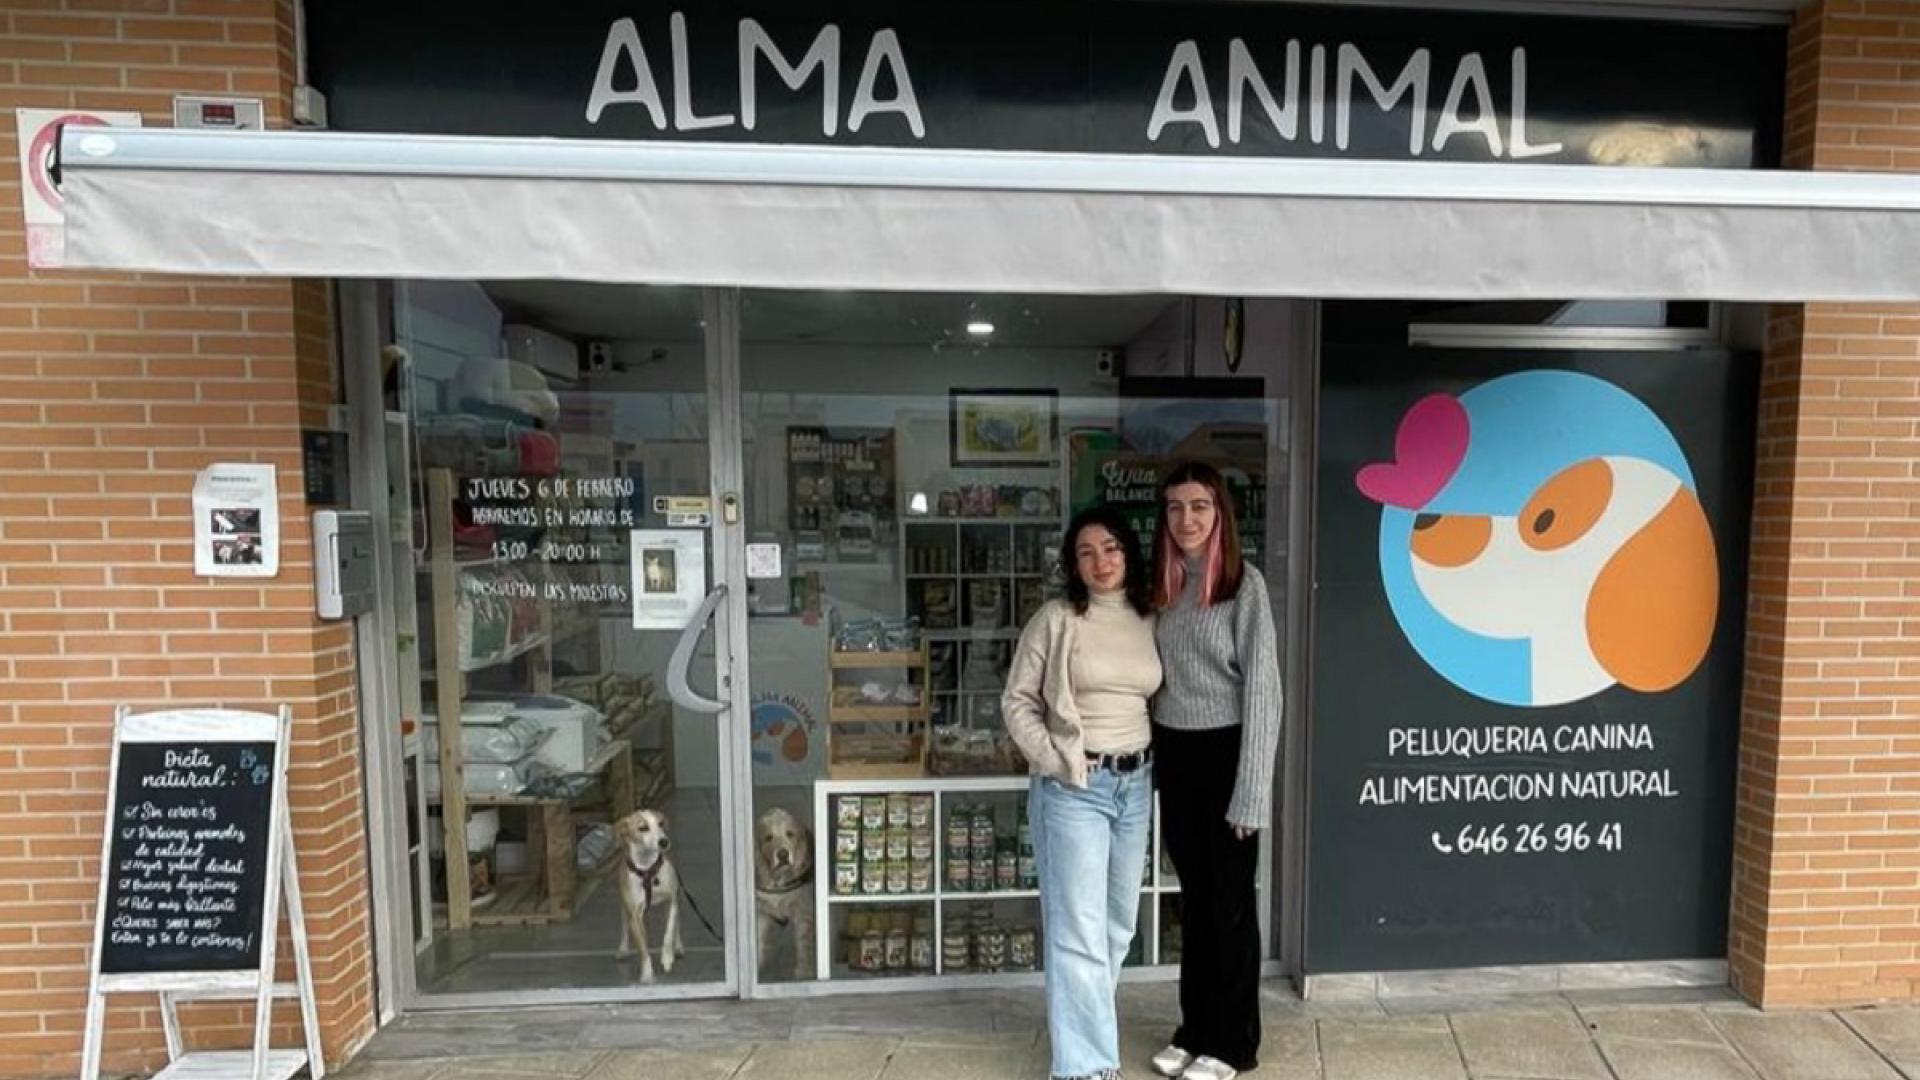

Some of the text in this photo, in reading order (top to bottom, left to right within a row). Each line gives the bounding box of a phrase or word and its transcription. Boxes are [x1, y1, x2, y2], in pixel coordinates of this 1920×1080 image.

[587, 11, 925, 138] ALMA
[1147, 37, 1563, 157] ANIMAL
[468, 478, 634, 499] JUEVES 6 DE FEBRERO
[545, 507, 563, 527] EN
[569, 509, 616, 527] HORARIO
[620, 510, 634, 527] DE
[544, 583, 565, 601] LAS
[1389, 723, 1654, 758] PELUQUERIA CANINA
[165, 748, 213, 768] Dieta
[1359, 768, 1679, 805] ALIMENTACION NATURAL
[1458, 821, 1622, 855] 646 26 96 41
